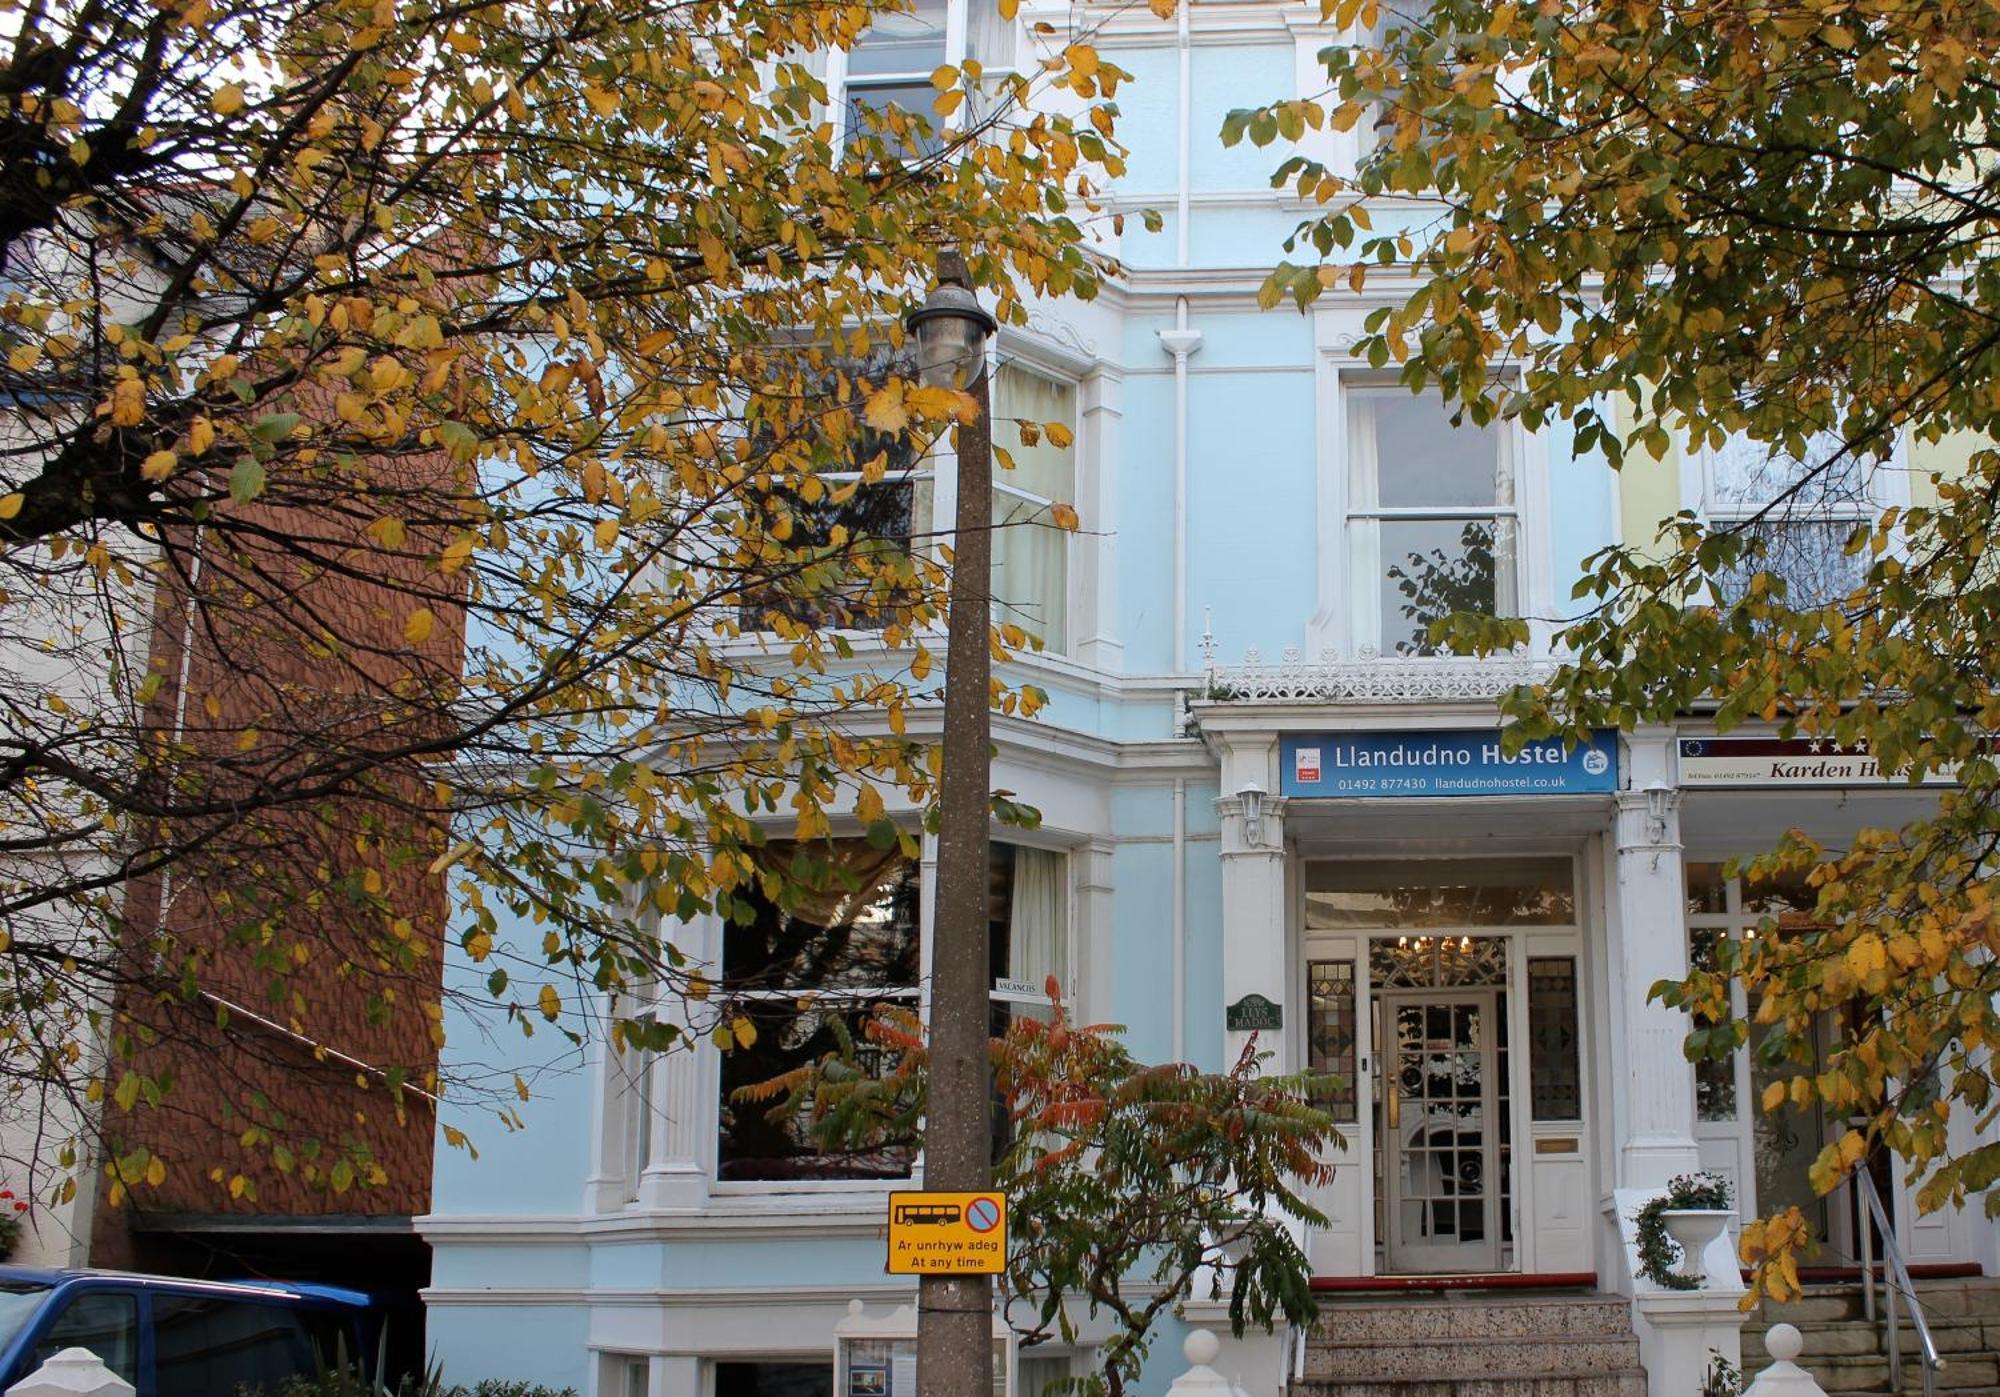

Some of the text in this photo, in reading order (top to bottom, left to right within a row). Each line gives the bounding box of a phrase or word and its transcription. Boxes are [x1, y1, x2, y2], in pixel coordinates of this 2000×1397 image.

[1336, 744, 1471, 767] Llandudno
[1770, 761, 1855, 778] Karden
[1338, 776, 1566, 790] 01492 877430 llandudnohostel.co.uk
[898, 1240, 998, 1252] Ar unrhyw adeg
[911, 1257, 985, 1269] At any time
